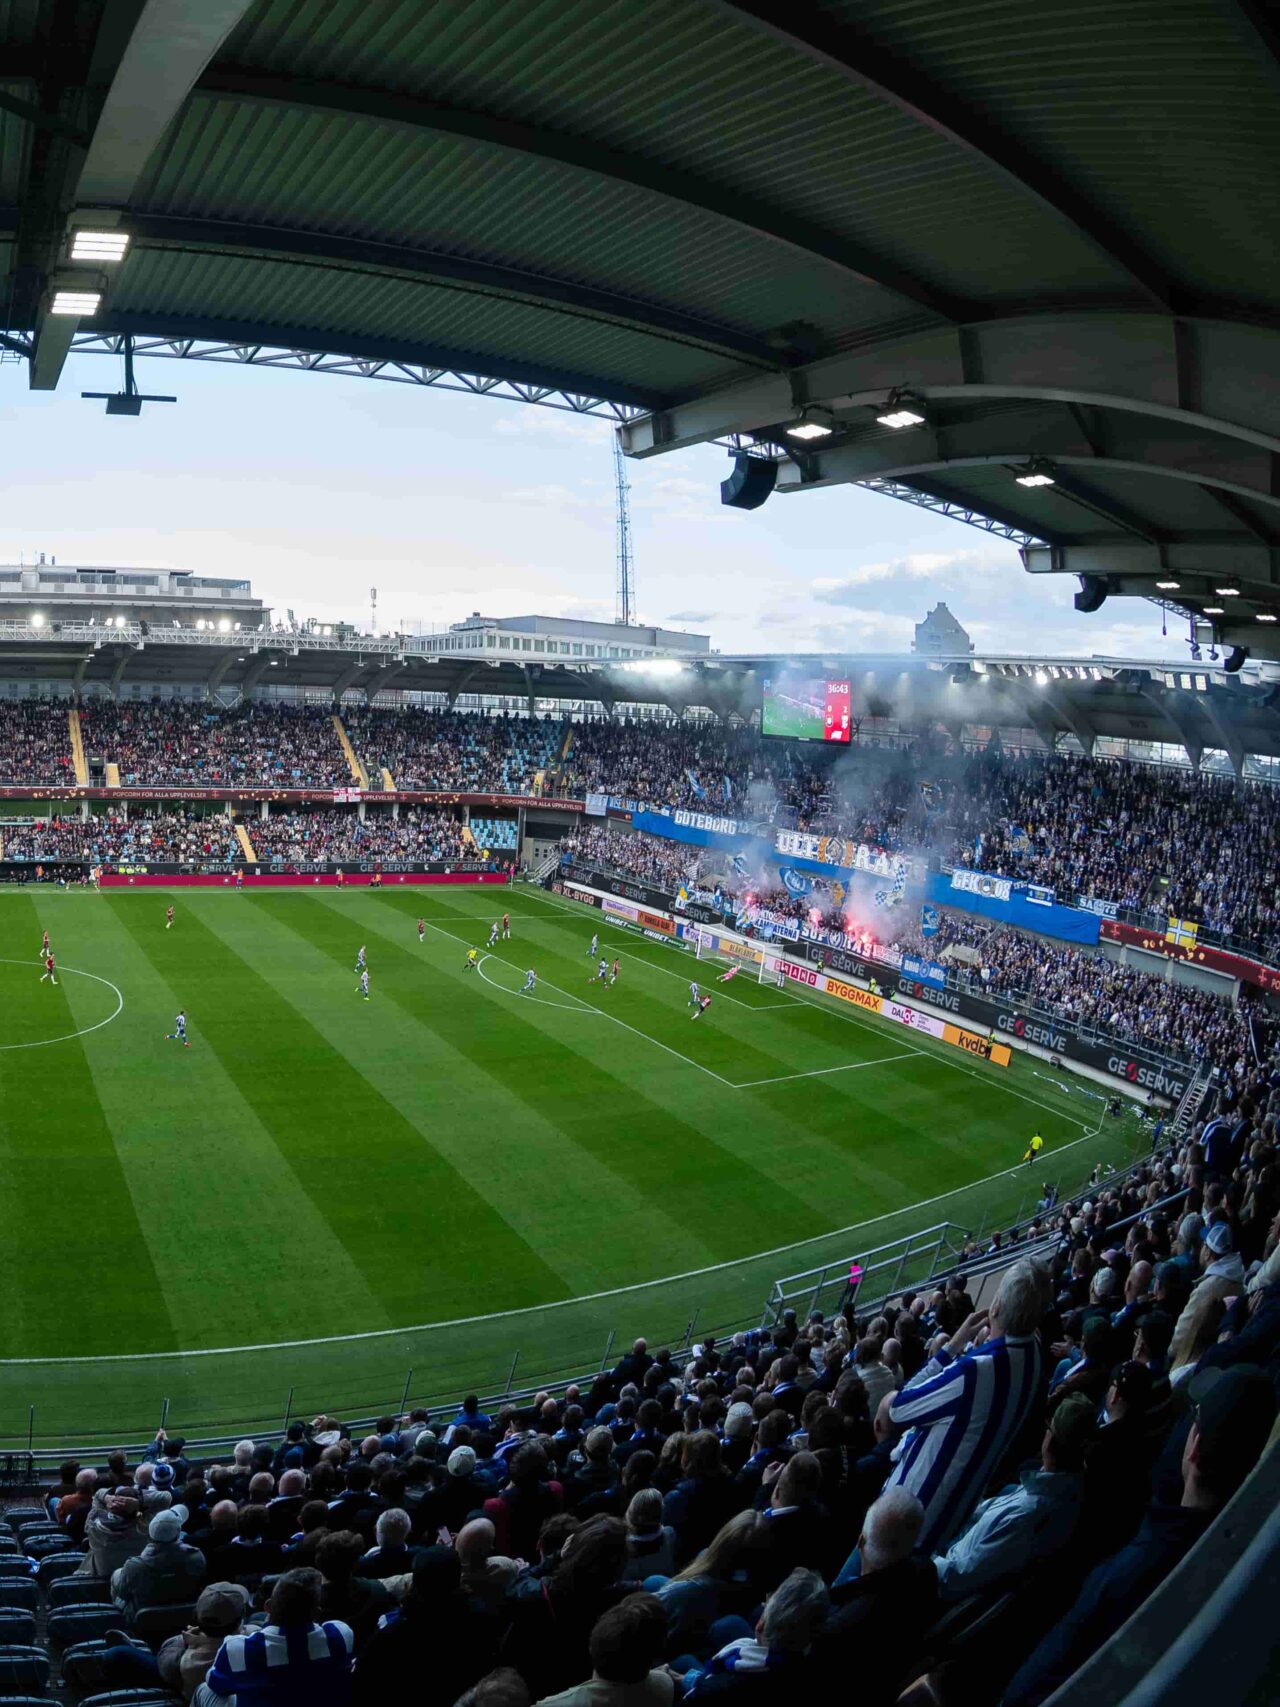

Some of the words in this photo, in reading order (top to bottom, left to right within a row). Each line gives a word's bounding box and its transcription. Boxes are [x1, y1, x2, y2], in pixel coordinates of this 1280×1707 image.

[828, 684, 849, 694] 36:43
[674, 810, 738, 835] GÖTEBORG
[270, 864, 328, 873] GEOSERVE
[360, 864, 414, 872] GEOSERVE
[562, 888, 595, 905] XL-BYGG
[612, 882, 647, 902] GEOSERVE
[605, 914, 628, 928] UNIBET
[644, 929, 669, 943] UNIBET
[811, 948, 866, 977] GEOSERVE
[827, 980, 880, 1010] BYGGMAX
[898, 978, 960, 1011] GEOSERVE
[891, 1006, 915, 1024] DALOC
[958, 1031, 987, 1055] kvdb
[997, 1014, 1067, 1052] GEOSERVE
[1108, 1056, 1184, 1098] GEOSERVE
